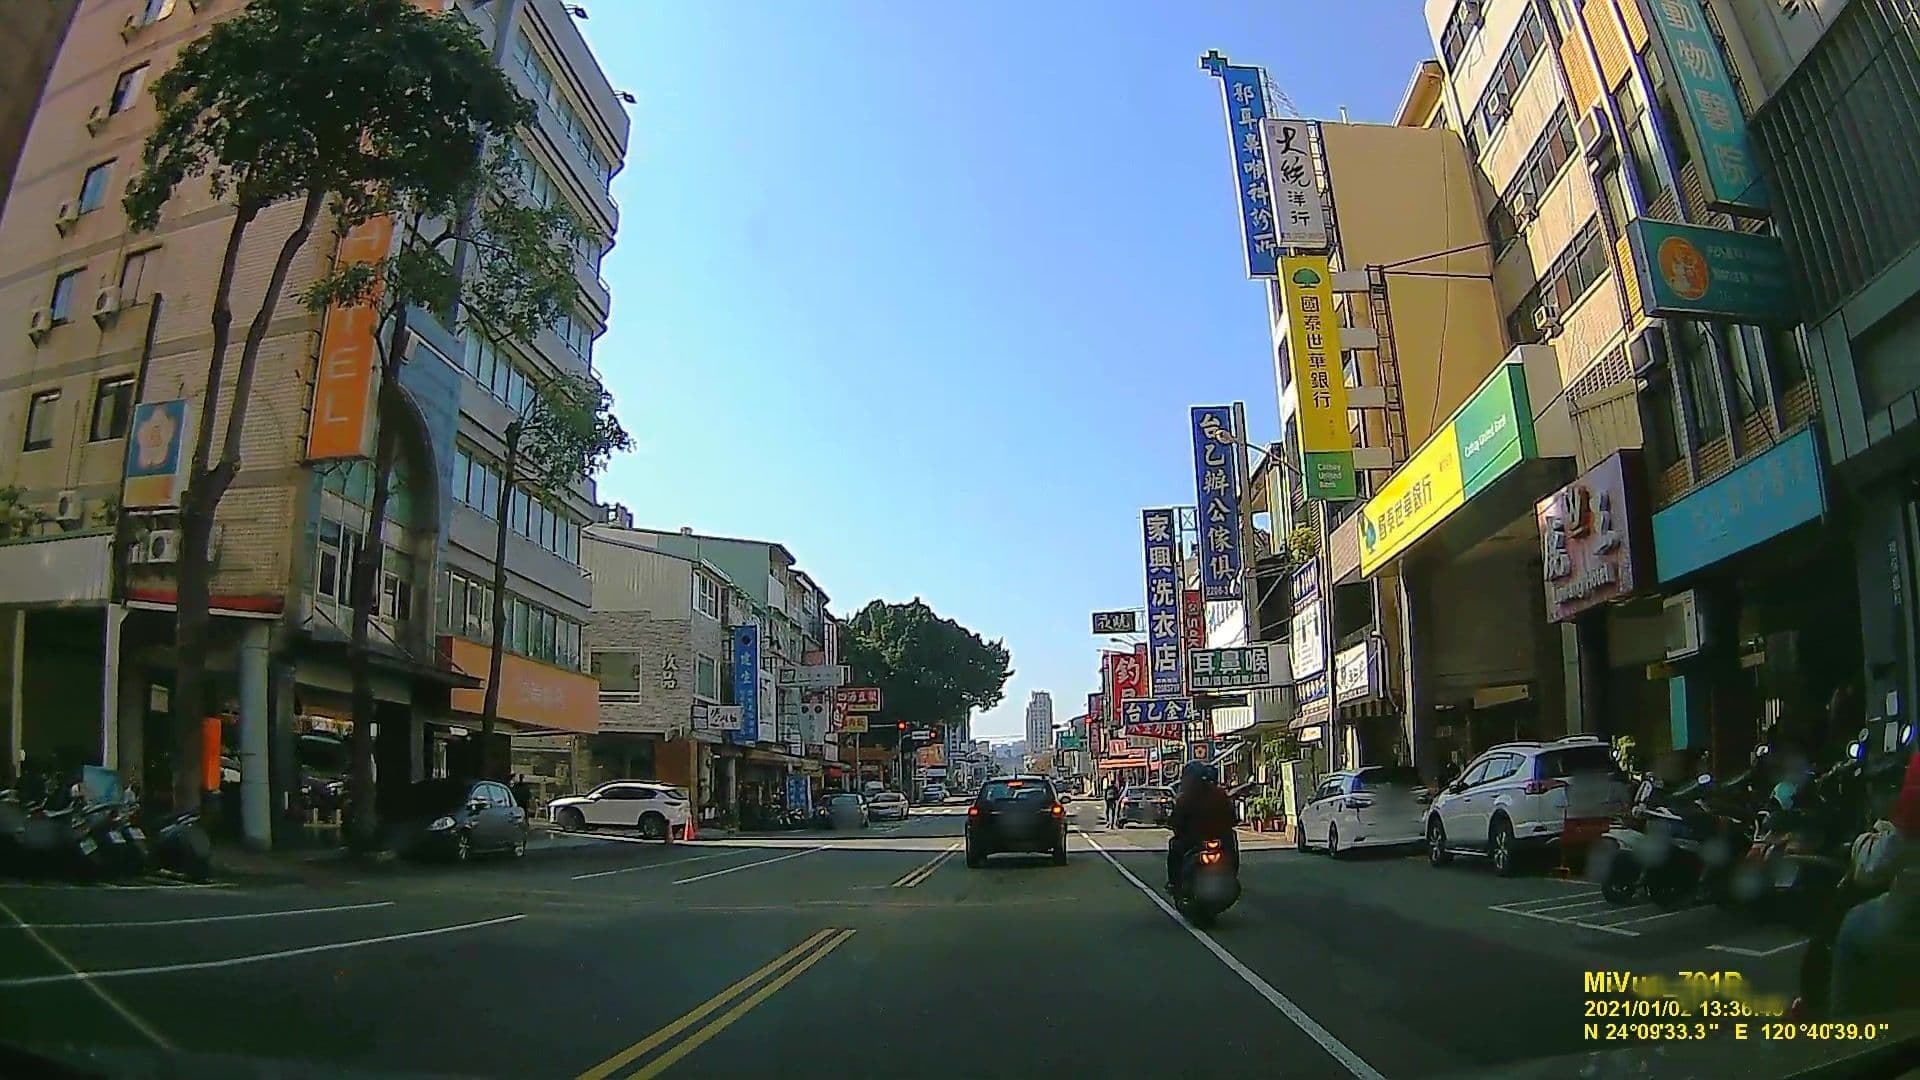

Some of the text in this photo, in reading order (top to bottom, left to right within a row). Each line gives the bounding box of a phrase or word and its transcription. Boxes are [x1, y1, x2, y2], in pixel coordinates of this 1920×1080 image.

[1301, 296, 1331, 408] 國泰世華銀行
[1147, 514, 1177, 672] 家興洗衣店
[1193, 648, 1267, 675] 耳鼻喉
